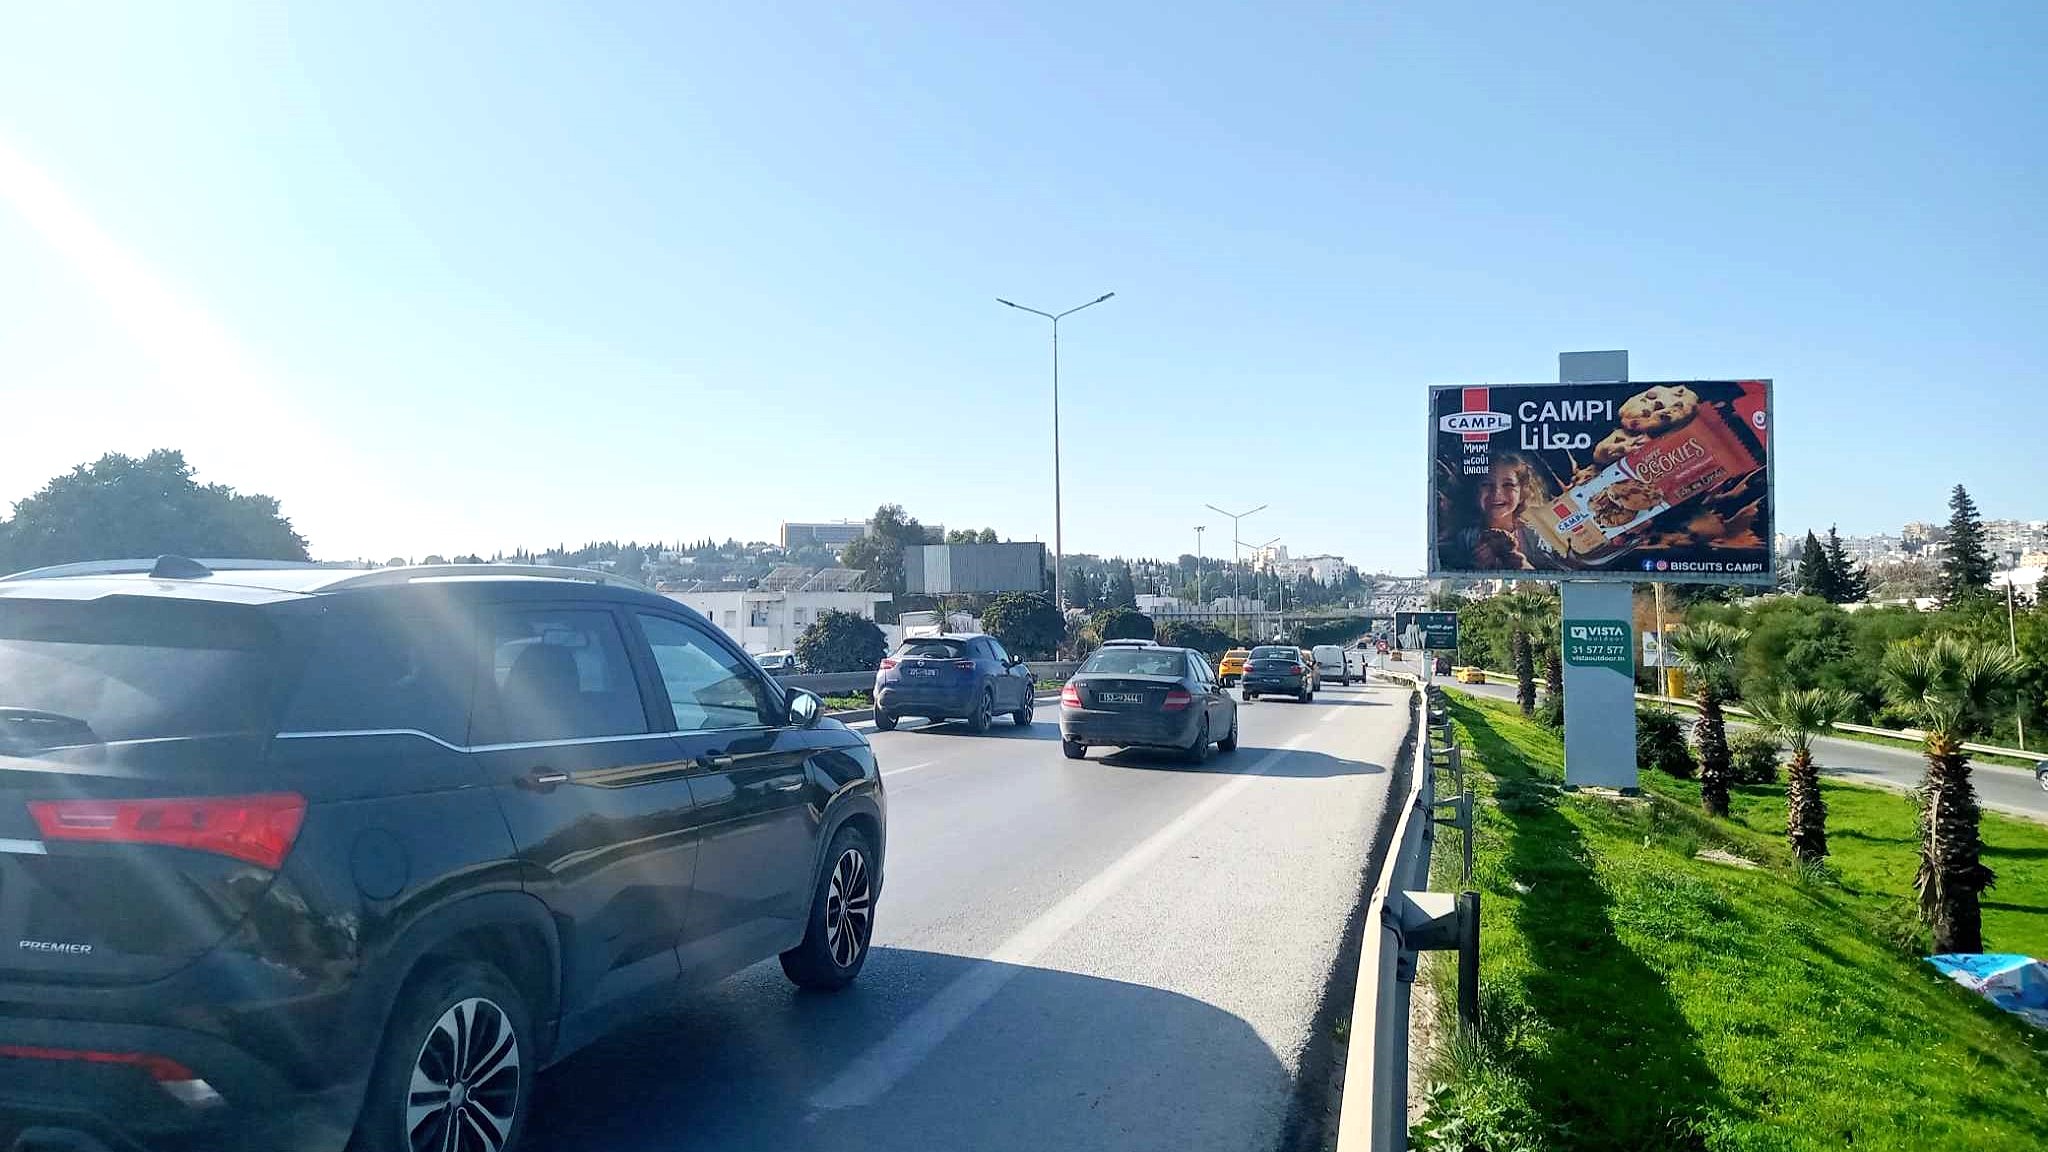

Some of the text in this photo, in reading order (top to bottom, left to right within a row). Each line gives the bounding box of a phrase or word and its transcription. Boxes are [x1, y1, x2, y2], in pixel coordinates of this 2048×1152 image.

[1518, 400, 1613, 422] CAMPI
[1447, 417, 1502, 429] CAMPI
[1520, 424, 1592, 450] معانا
[1463, 465, 1489, 475] UNIQUE
[1558, 513, 1589, 531] CAMPI
[1670, 561, 1763, 572] BISCUITS CAMPI
[1588, 626, 1624, 636] VISTA
[1571, 645, 1624, 654] 31 577 577
[19, 940, 93, 955] PREMIER
